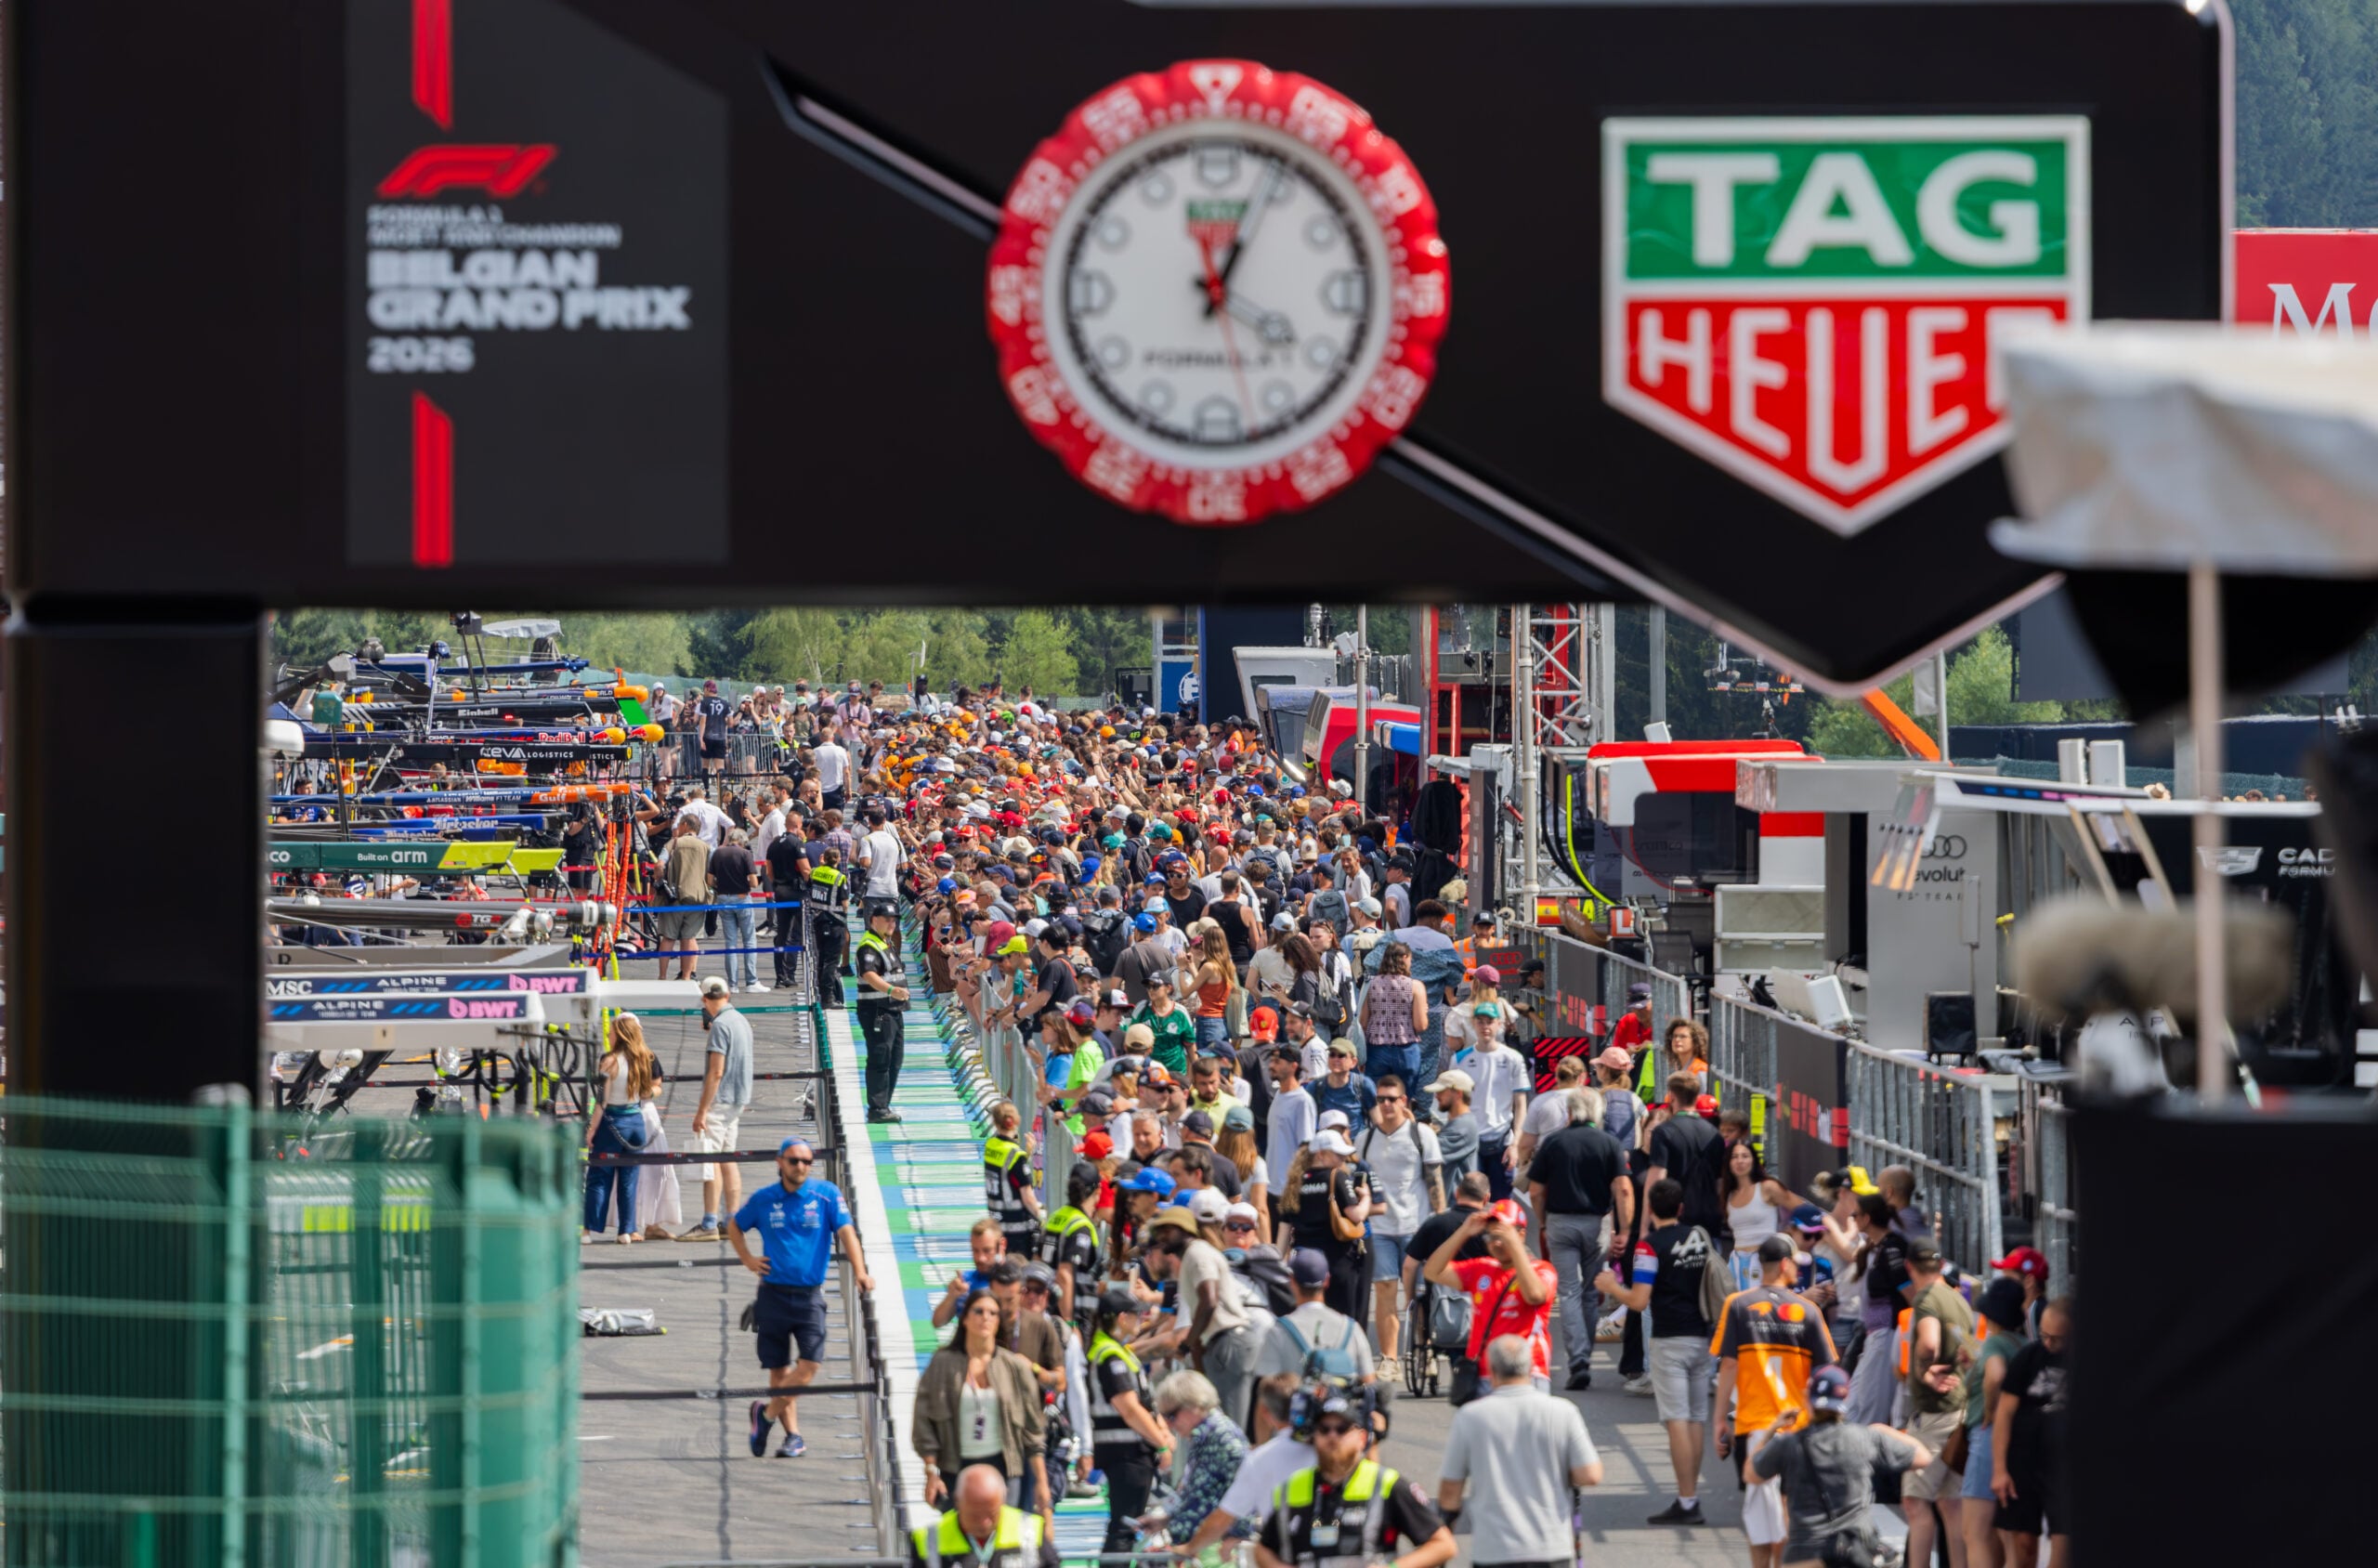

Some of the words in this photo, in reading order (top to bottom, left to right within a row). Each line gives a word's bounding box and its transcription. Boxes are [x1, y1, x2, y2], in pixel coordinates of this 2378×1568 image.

[1647, 150, 2043, 268] TAG
[367, 249, 598, 289] BELGIAN
[367, 289, 560, 329] GRAND
[562, 287, 693, 329] PRIX
[367, 336, 475, 372] 2026
[458, 708, 499, 717] Einhell
[710, 703, 725, 715] 19
[539, 731, 562, 743] Red
[527, 751, 574, 759] LOGISTICS
[538, 793, 567, 803] Gulf
[358, 853, 376, 861] Built
[377, 854, 388, 862] on
[391, 850, 427, 864] arm
[266, 980, 312, 996] MSC
[376, 977, 447, 987] ALPINE
[529, 977, 578, 993] BWT
[311, 1000, 385, 1011] ALPINE
[469, 1001, 518, 1017] BWT
